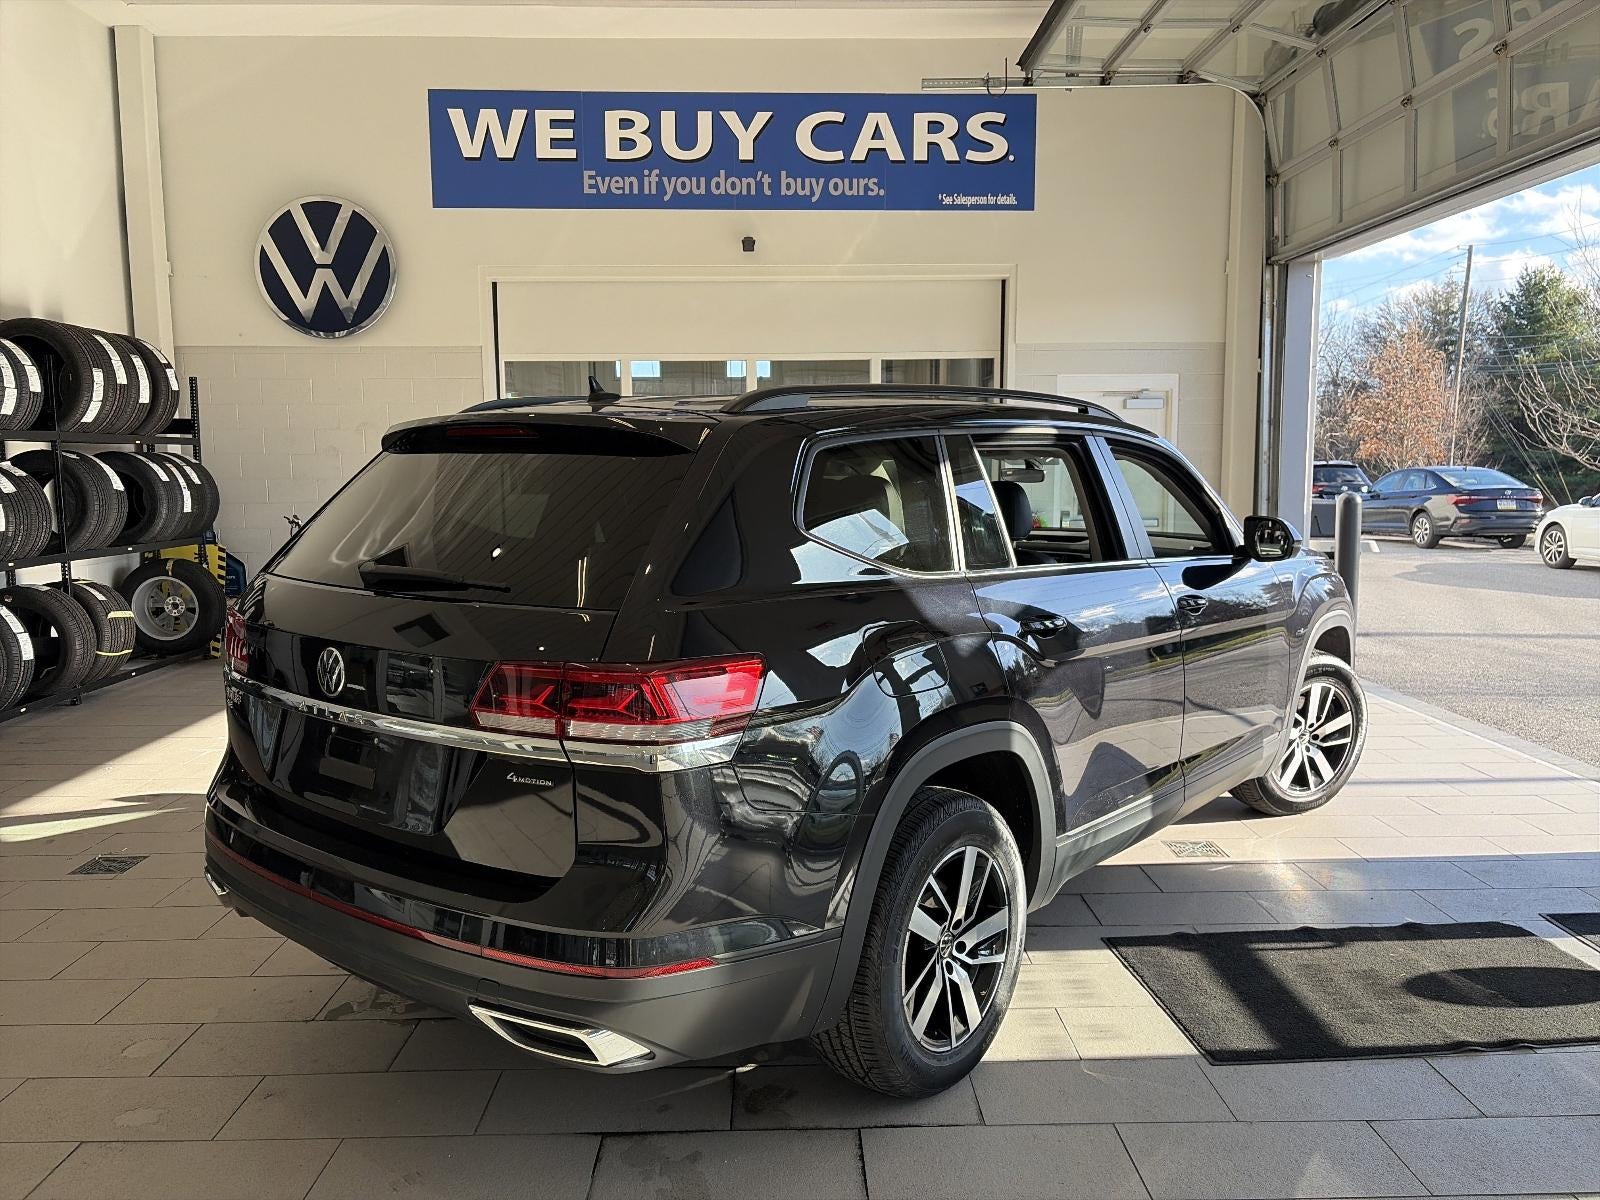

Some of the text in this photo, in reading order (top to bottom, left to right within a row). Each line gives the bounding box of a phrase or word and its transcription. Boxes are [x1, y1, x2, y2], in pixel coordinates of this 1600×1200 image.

[446, 107, 1015, 165] WE BUY CARS.
[583, 169, 885, 203] Even if you don't buy ours.
[942, 192, 1018, 208] See Salesperson for details.
[506, 772, 552, 786] 4MOTION
